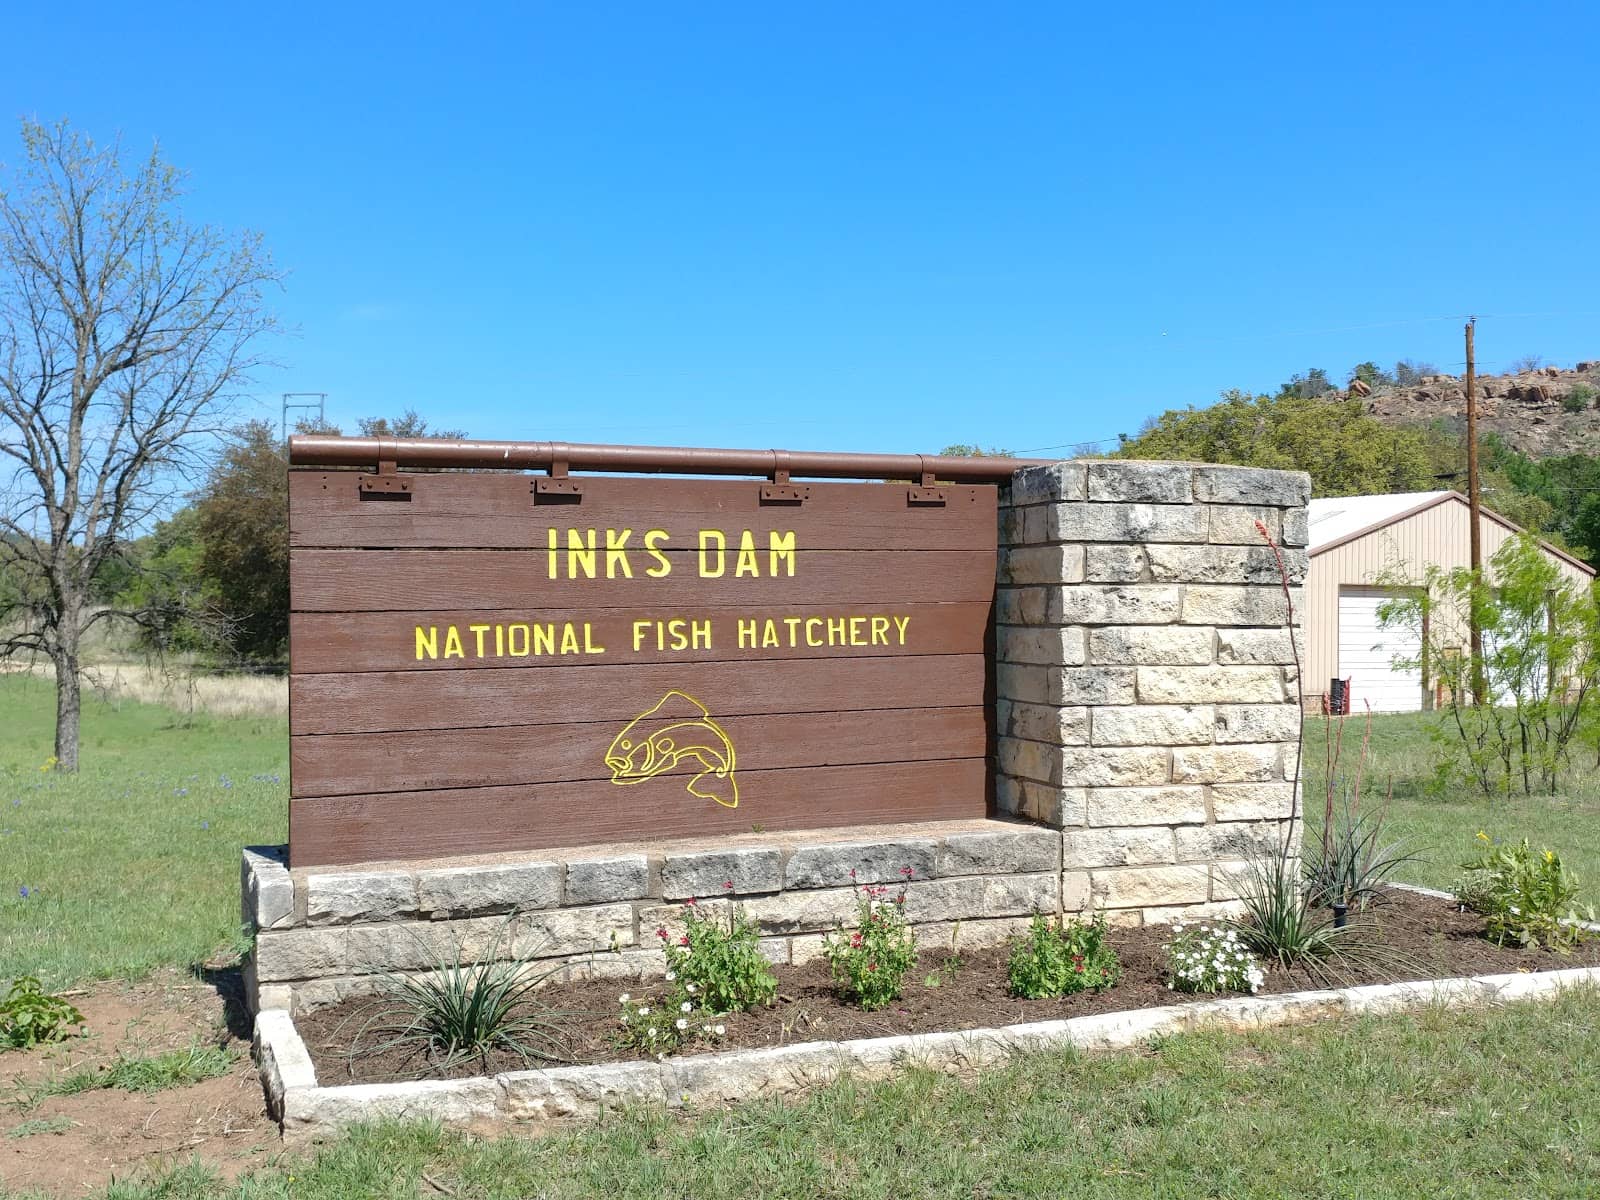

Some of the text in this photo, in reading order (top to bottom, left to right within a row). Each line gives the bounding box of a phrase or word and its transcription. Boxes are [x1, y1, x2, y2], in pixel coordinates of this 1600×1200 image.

[547, 528, 796, 580] INKS DAM
[415, 616, 910, 661] NATIONAL FISH HATCHERY
